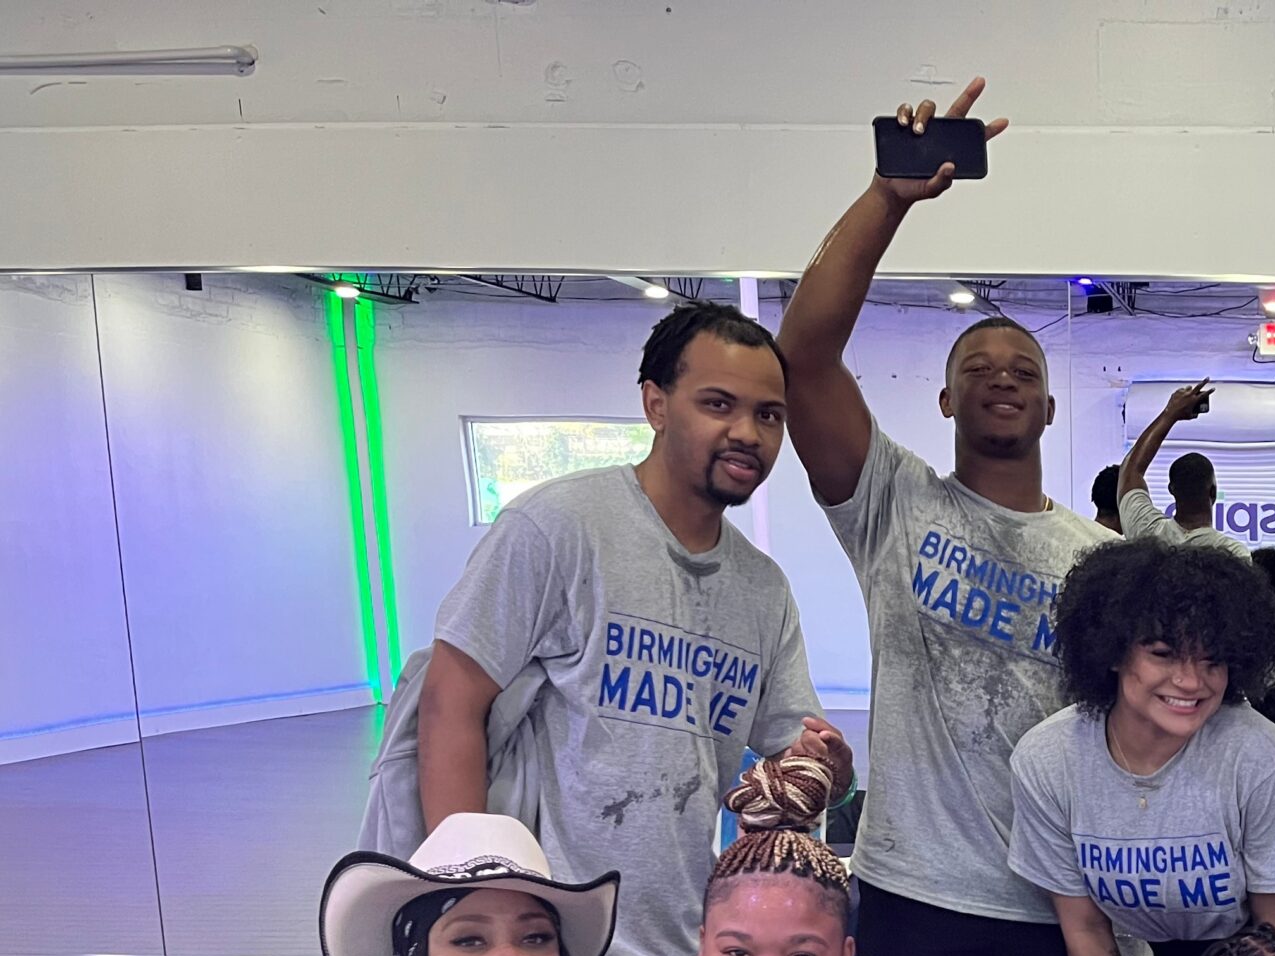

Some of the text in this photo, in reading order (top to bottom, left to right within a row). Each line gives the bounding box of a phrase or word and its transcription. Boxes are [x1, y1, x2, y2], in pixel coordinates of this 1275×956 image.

[912, 561, 1021, 641] MADE
[709, 691, 748, 736] E
[1081, 841, 1229, 874] IRMINGHAM
[1178, 873, 1236, 908] ME
